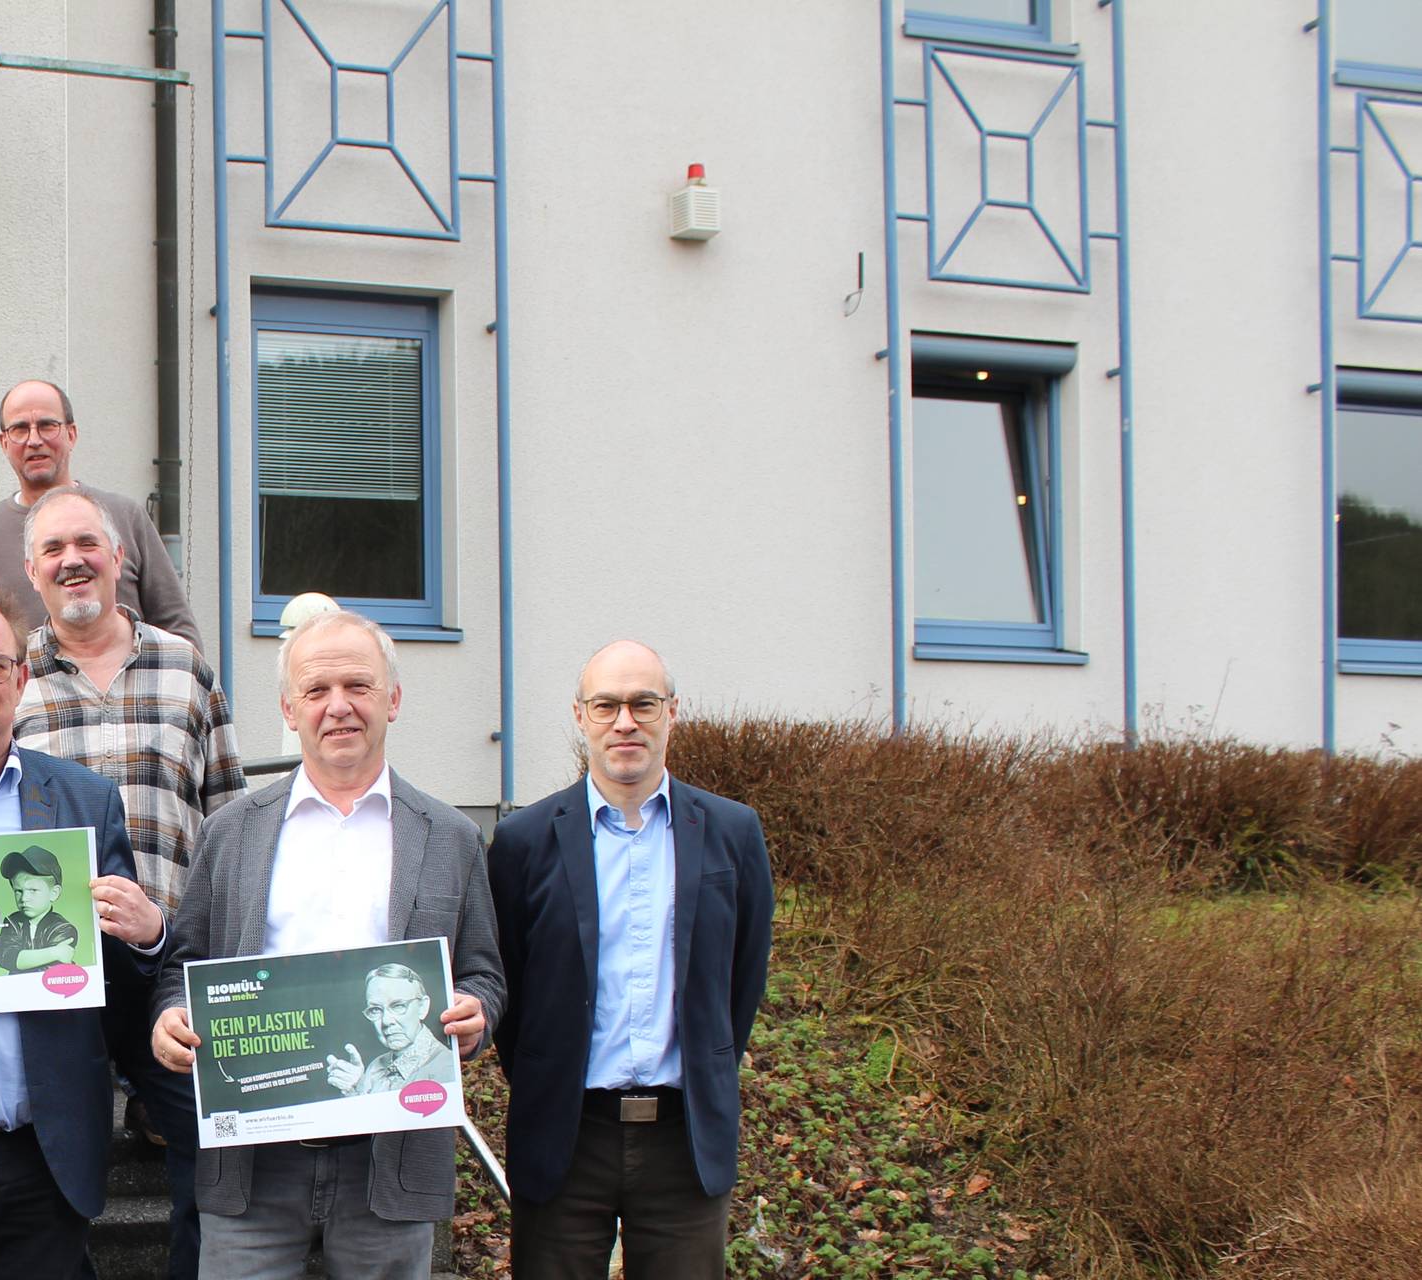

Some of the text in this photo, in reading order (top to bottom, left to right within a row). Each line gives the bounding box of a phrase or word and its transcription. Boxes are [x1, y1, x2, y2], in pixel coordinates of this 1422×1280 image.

[207, 979, 264, 995] BIOMÜLL
[208, 992, 258, 1004] kann mehr.
[210, 1008, 325, 1037] KEIN PLASTIK IN
[212, 1031, 315, 1058] DIE BIOTONNE.
